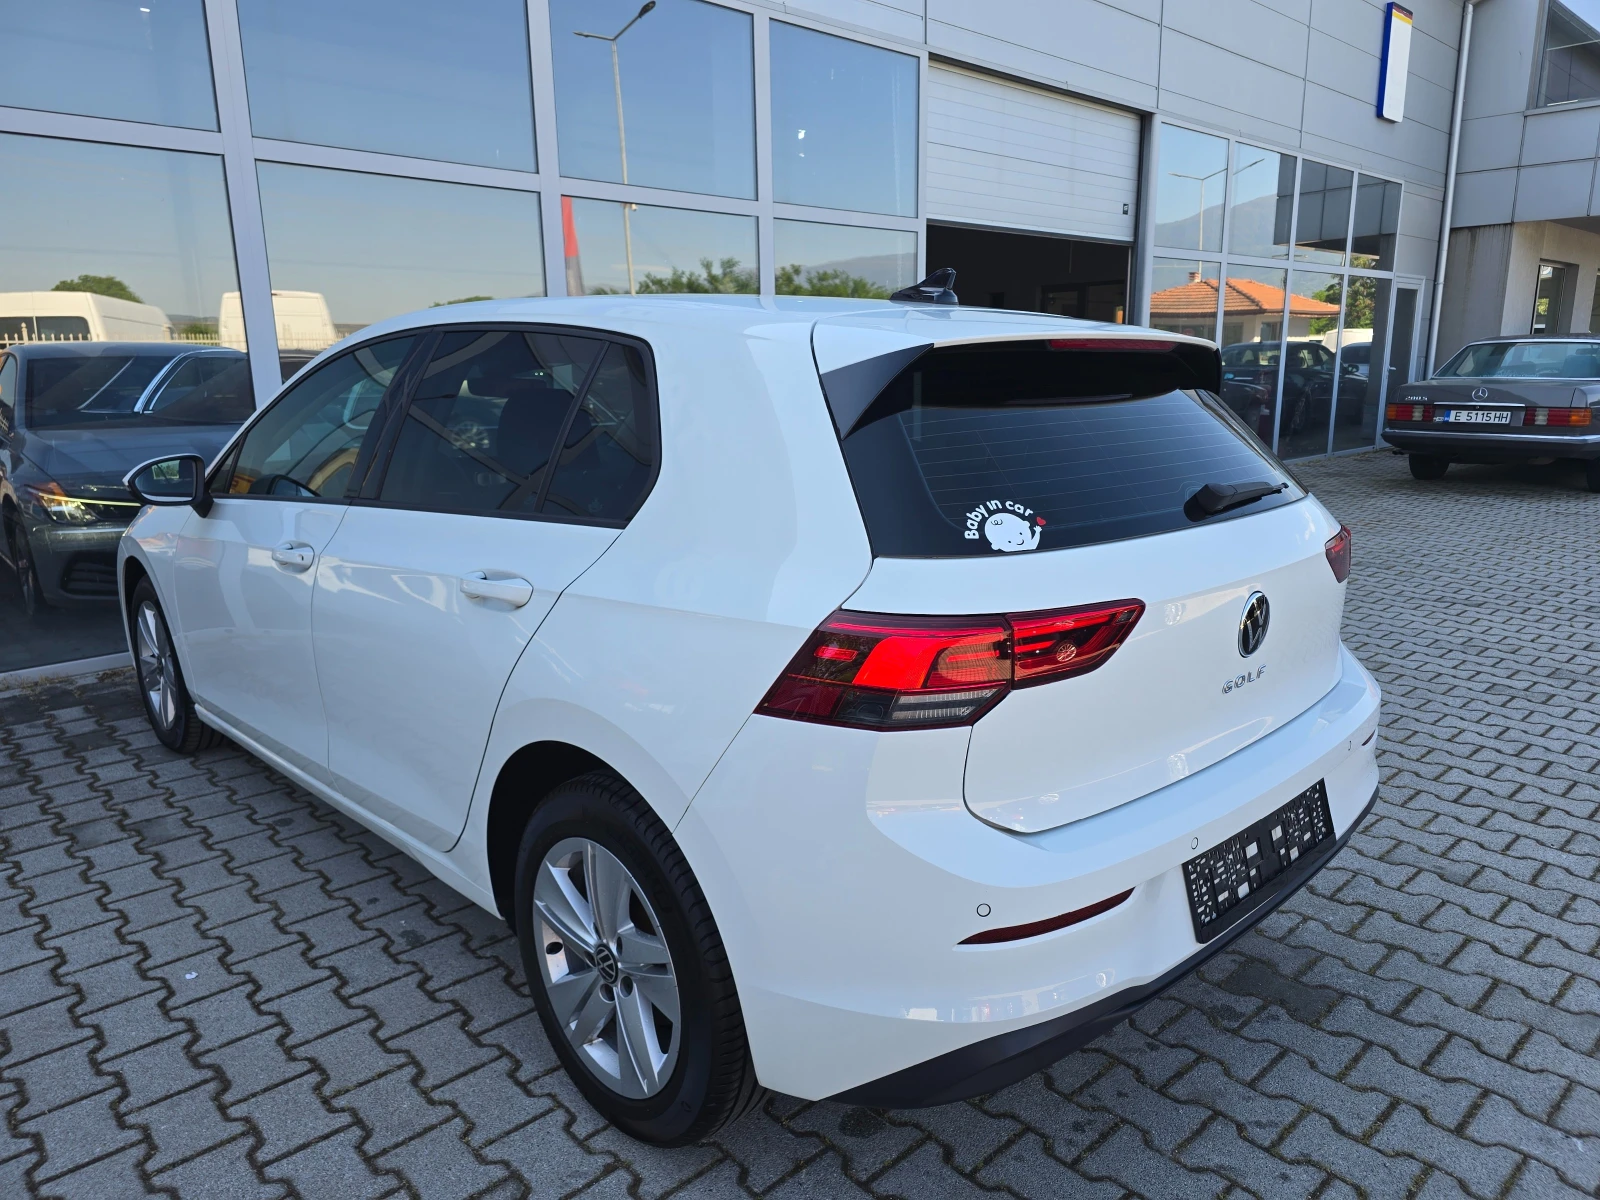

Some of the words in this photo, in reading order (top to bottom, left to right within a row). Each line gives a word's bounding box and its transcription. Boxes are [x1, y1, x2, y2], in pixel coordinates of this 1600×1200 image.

[1454, 411, 1462, 421] E
[1465, 411, 1492, 422] 5115
[964, 504, 989, 539] Baby
[986, 499, 1003, 511] in
[1005, 500, 1034, 517] car
[1221, 664, 1266, 694] GOLF
